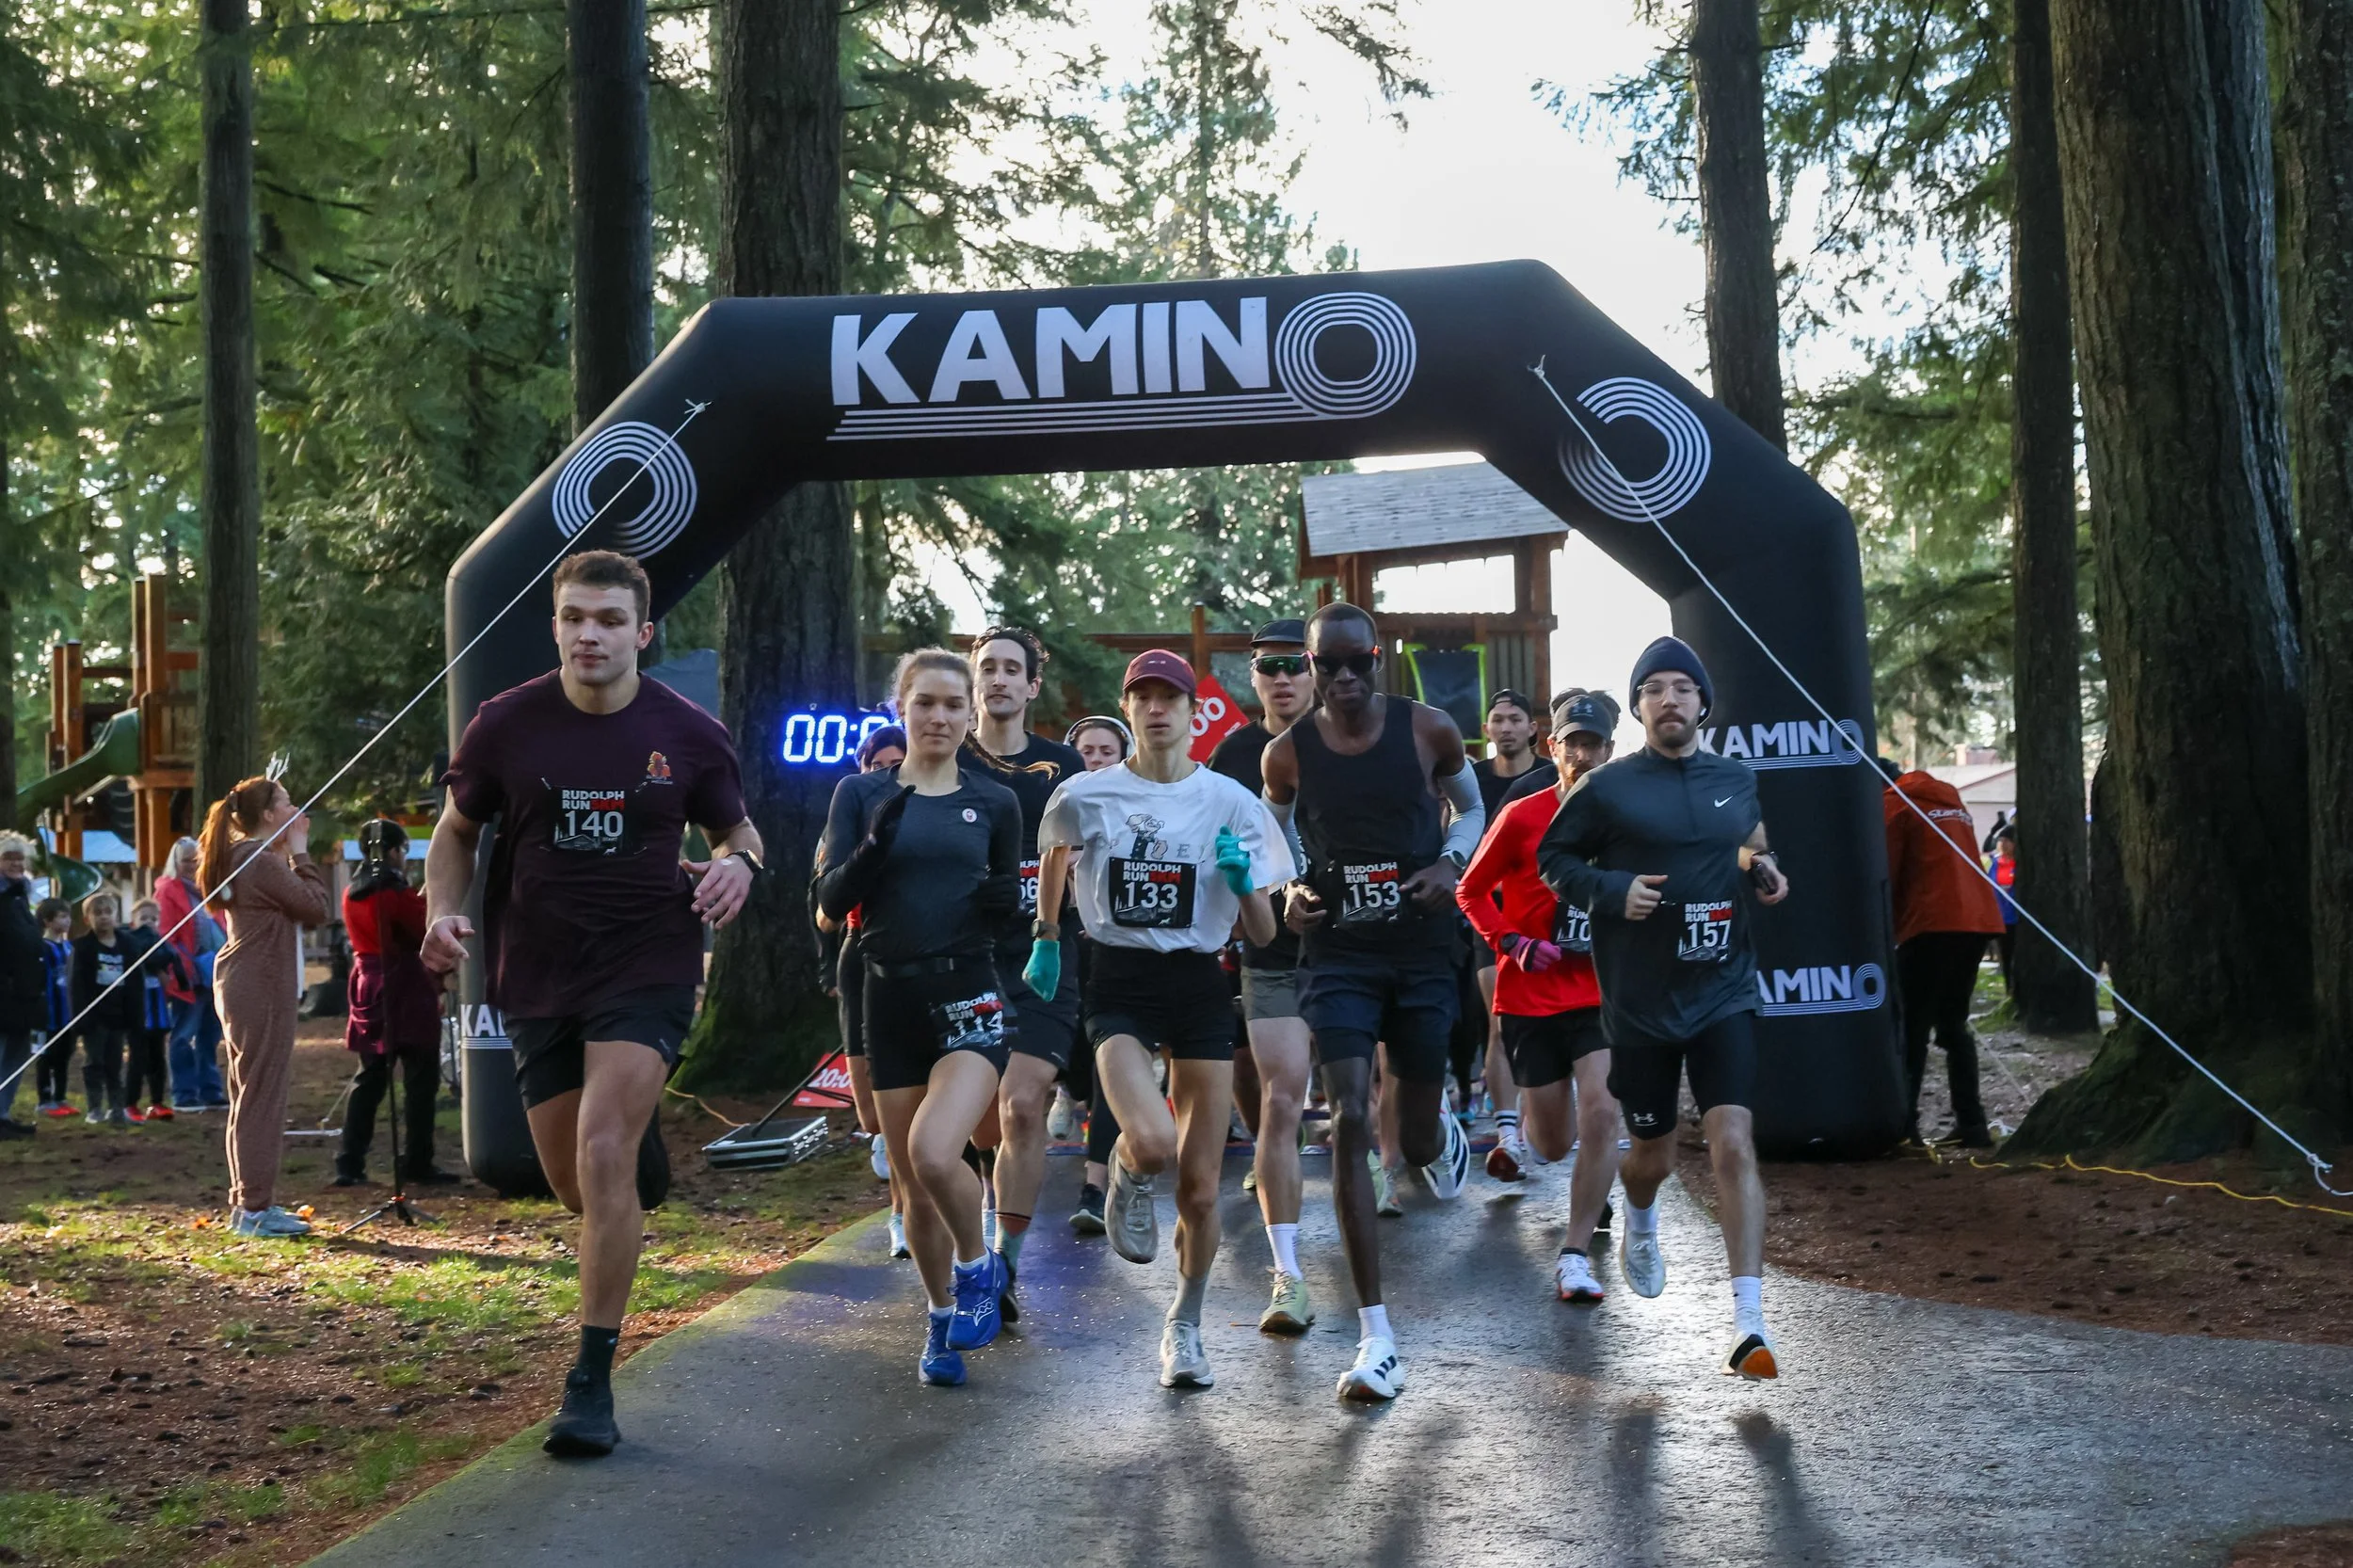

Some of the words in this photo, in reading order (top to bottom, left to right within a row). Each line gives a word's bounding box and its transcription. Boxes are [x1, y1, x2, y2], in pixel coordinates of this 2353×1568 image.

[830, 292, 1417, 420] KAMINO
[1696, 719, 1865, 765] KAMINO
[562, 790, 625, 801] RUDOLPH
[565, 810, 624, 838] 140
[1123, 861, 1181, 873] RUDOLPH
[1343, 862, 1398, 874] RUDOLPH
[1124, 882, 1178, 909] 133
[1349, 881, 1401, 908] 153
[1685, 900, 1733, 913] RUDOLPH
[1568, 919, 1591, 941] 10
[1687, 920, 1731, 948] 157
